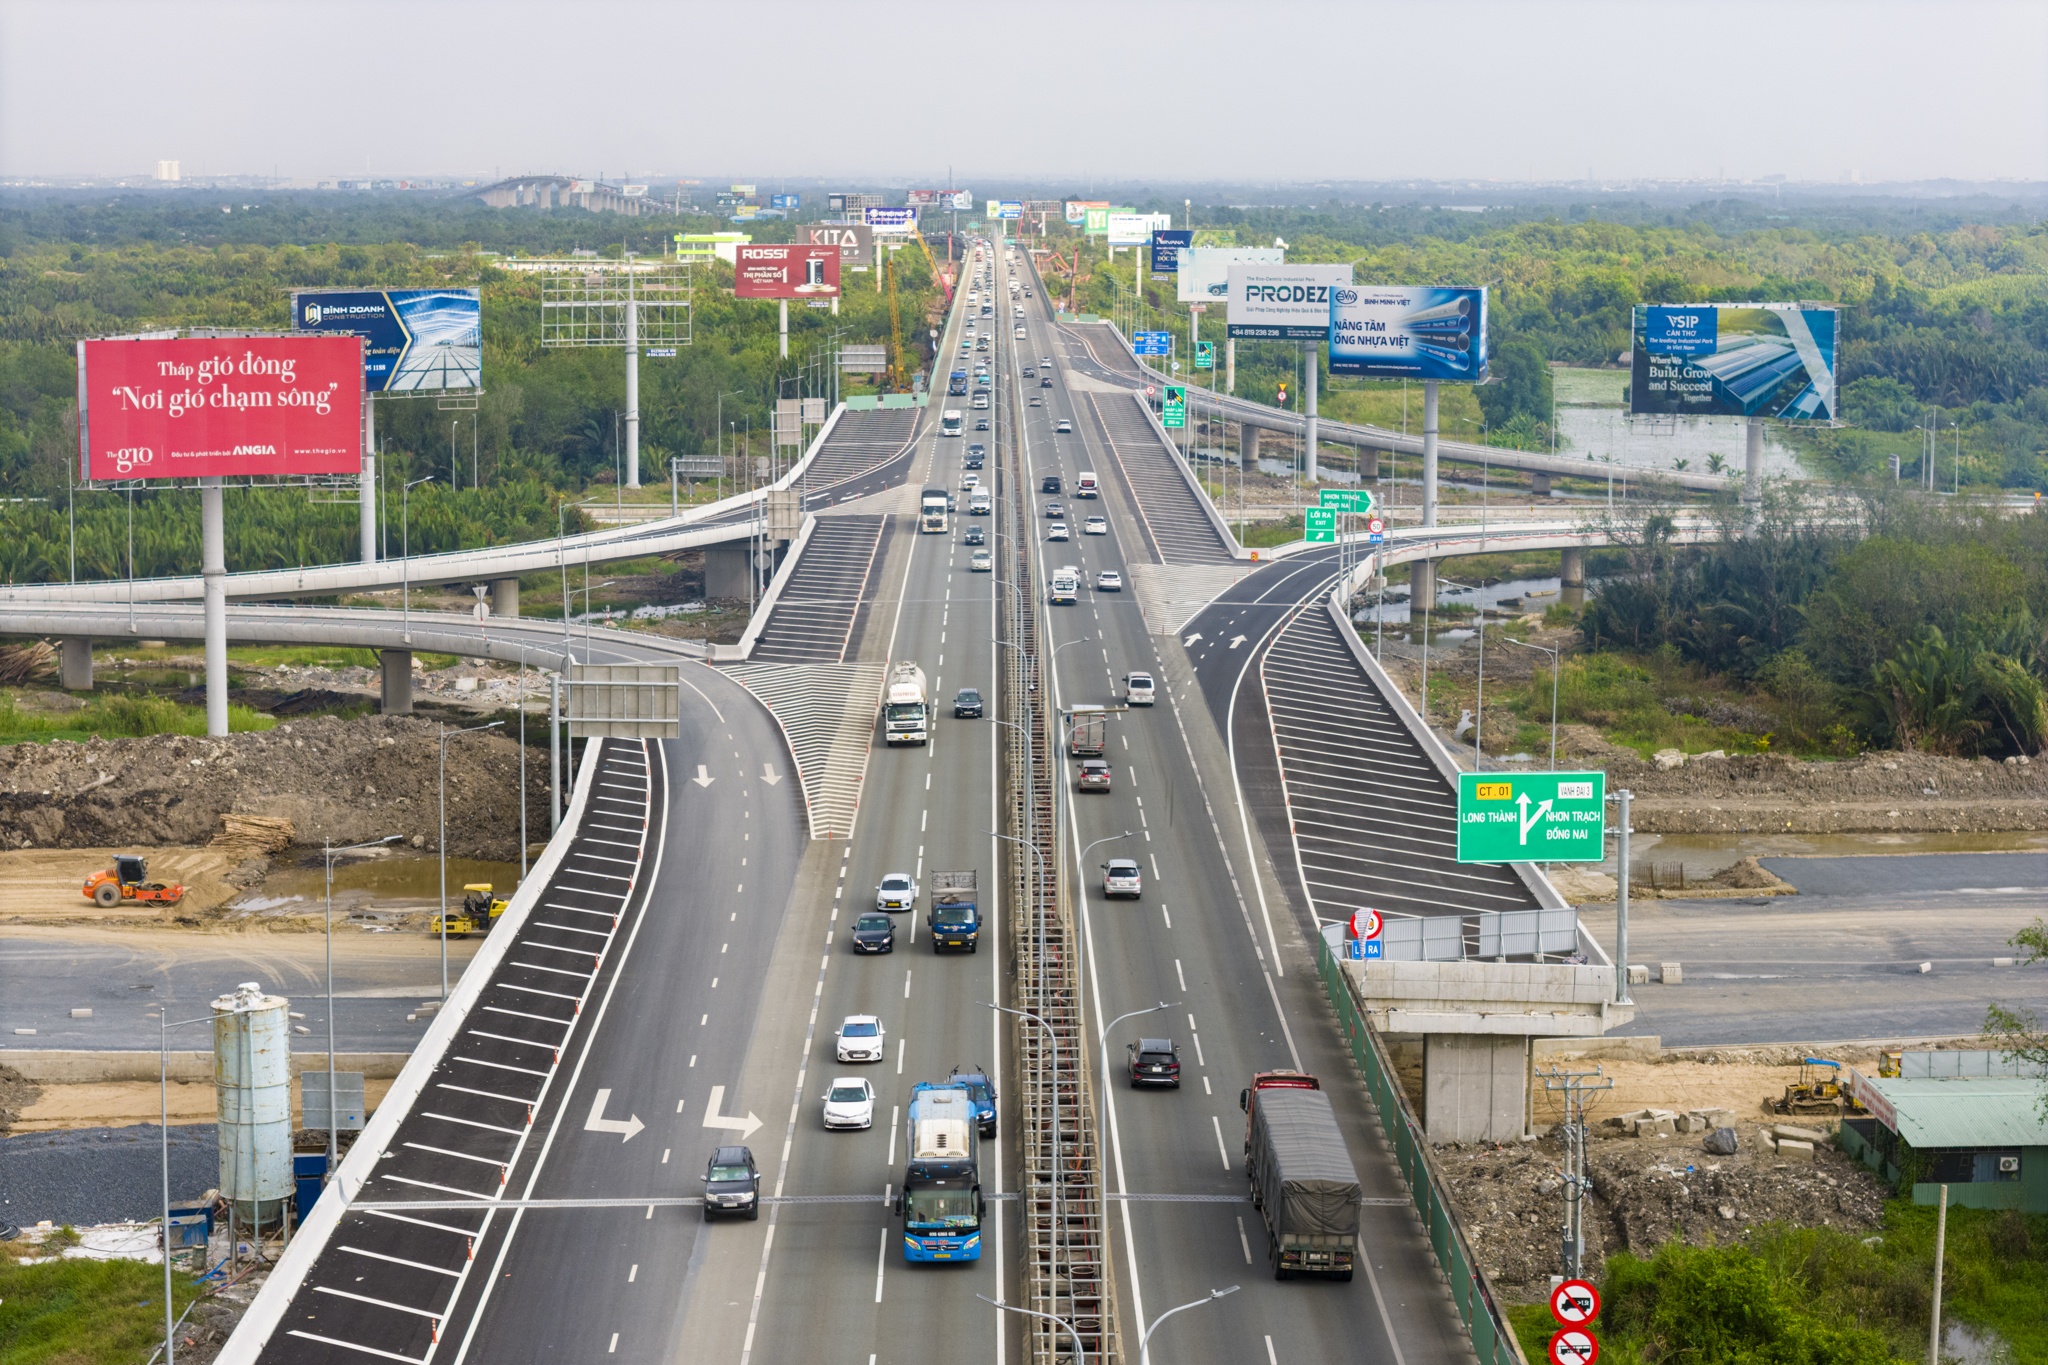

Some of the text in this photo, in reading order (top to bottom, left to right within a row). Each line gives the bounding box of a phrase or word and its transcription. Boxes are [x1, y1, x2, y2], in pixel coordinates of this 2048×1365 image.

[810, 230, 859, 247] KITA
[1156, 236, 1185, 245] NIRVANA
[742, 249, 787, 259] ROSSI
[781, 267, 787, 283] 1
[1246, 286, 1328, 303] PRODEZ
[323, 305, 347, 314] BÌNH
[1334, 319, 1385, 331] NÂNG TẦM
[1665, 315, 1699, 328] VSIP
[1334, 332, 1355, 345] ỐNG
[1358, 336, 1386, 348] NHỰA
[1390, 335, 1409, 349] VIỆT
[1650, 356, 1682, 364] Where We
[157, 351, 296, 385] Tháp gió đông
[1649, 367, 1712, 379] Build, Grow
[1648, 381, 1712, 391] and Succeed
[112, 383, 338, 418] “Nơi gió chạm sông”
[1683, 393, 1712, 403] Together
[232, 445, 276, 456] ANGIA
[1310, 510, 1320, 518] LỐI
[1560, 786, 1590, 796] VÀNH ĐAI 3
[1463, 809, 1517, 823] LONG THÀNH
[1546, 811, 1600, 824] NHƠN TRẠCH
[1573, 829, 1588, 839] NAI
[1368, 945, 1378, 954] RA
